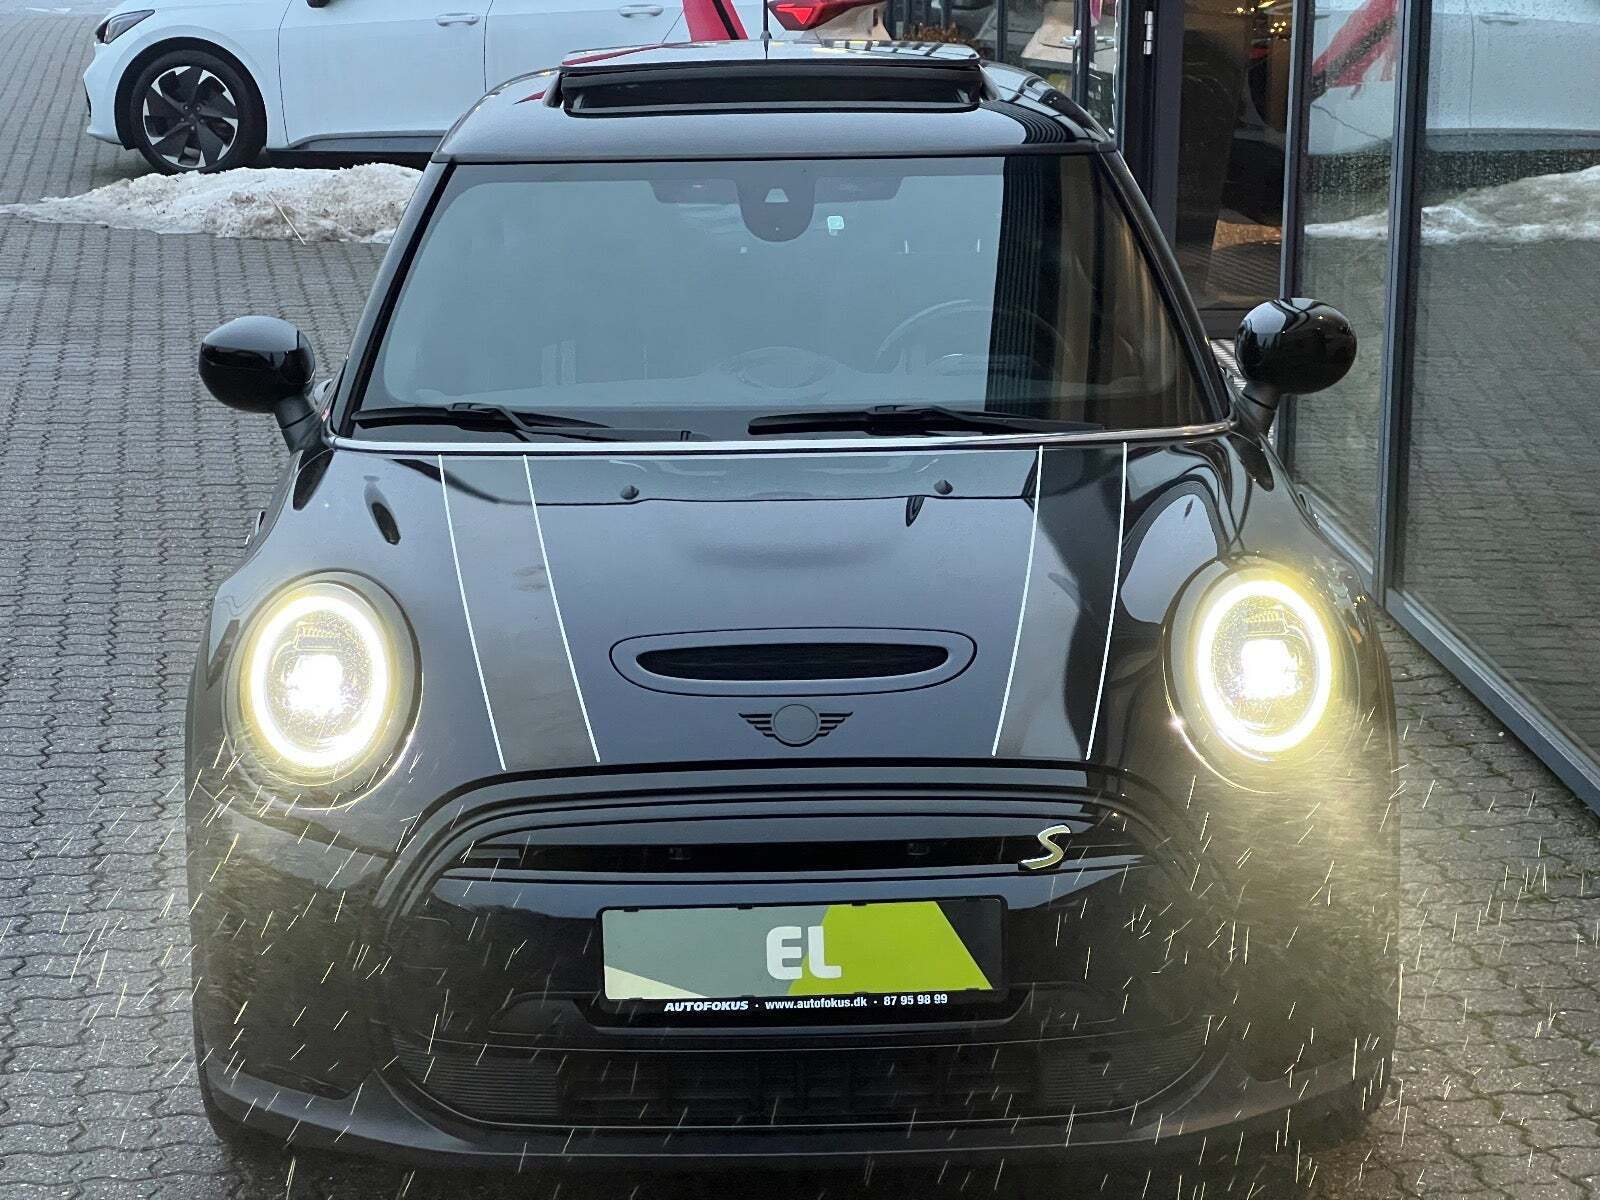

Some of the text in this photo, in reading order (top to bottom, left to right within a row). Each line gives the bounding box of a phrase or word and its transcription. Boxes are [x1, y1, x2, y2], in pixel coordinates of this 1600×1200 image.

[1019, 824, 1072, 870] S
[766, 925, 842, 980] EL
[663, 993, 948, 1012] AUTOFOKUS www.autofokus.dk 87 95 98 99
